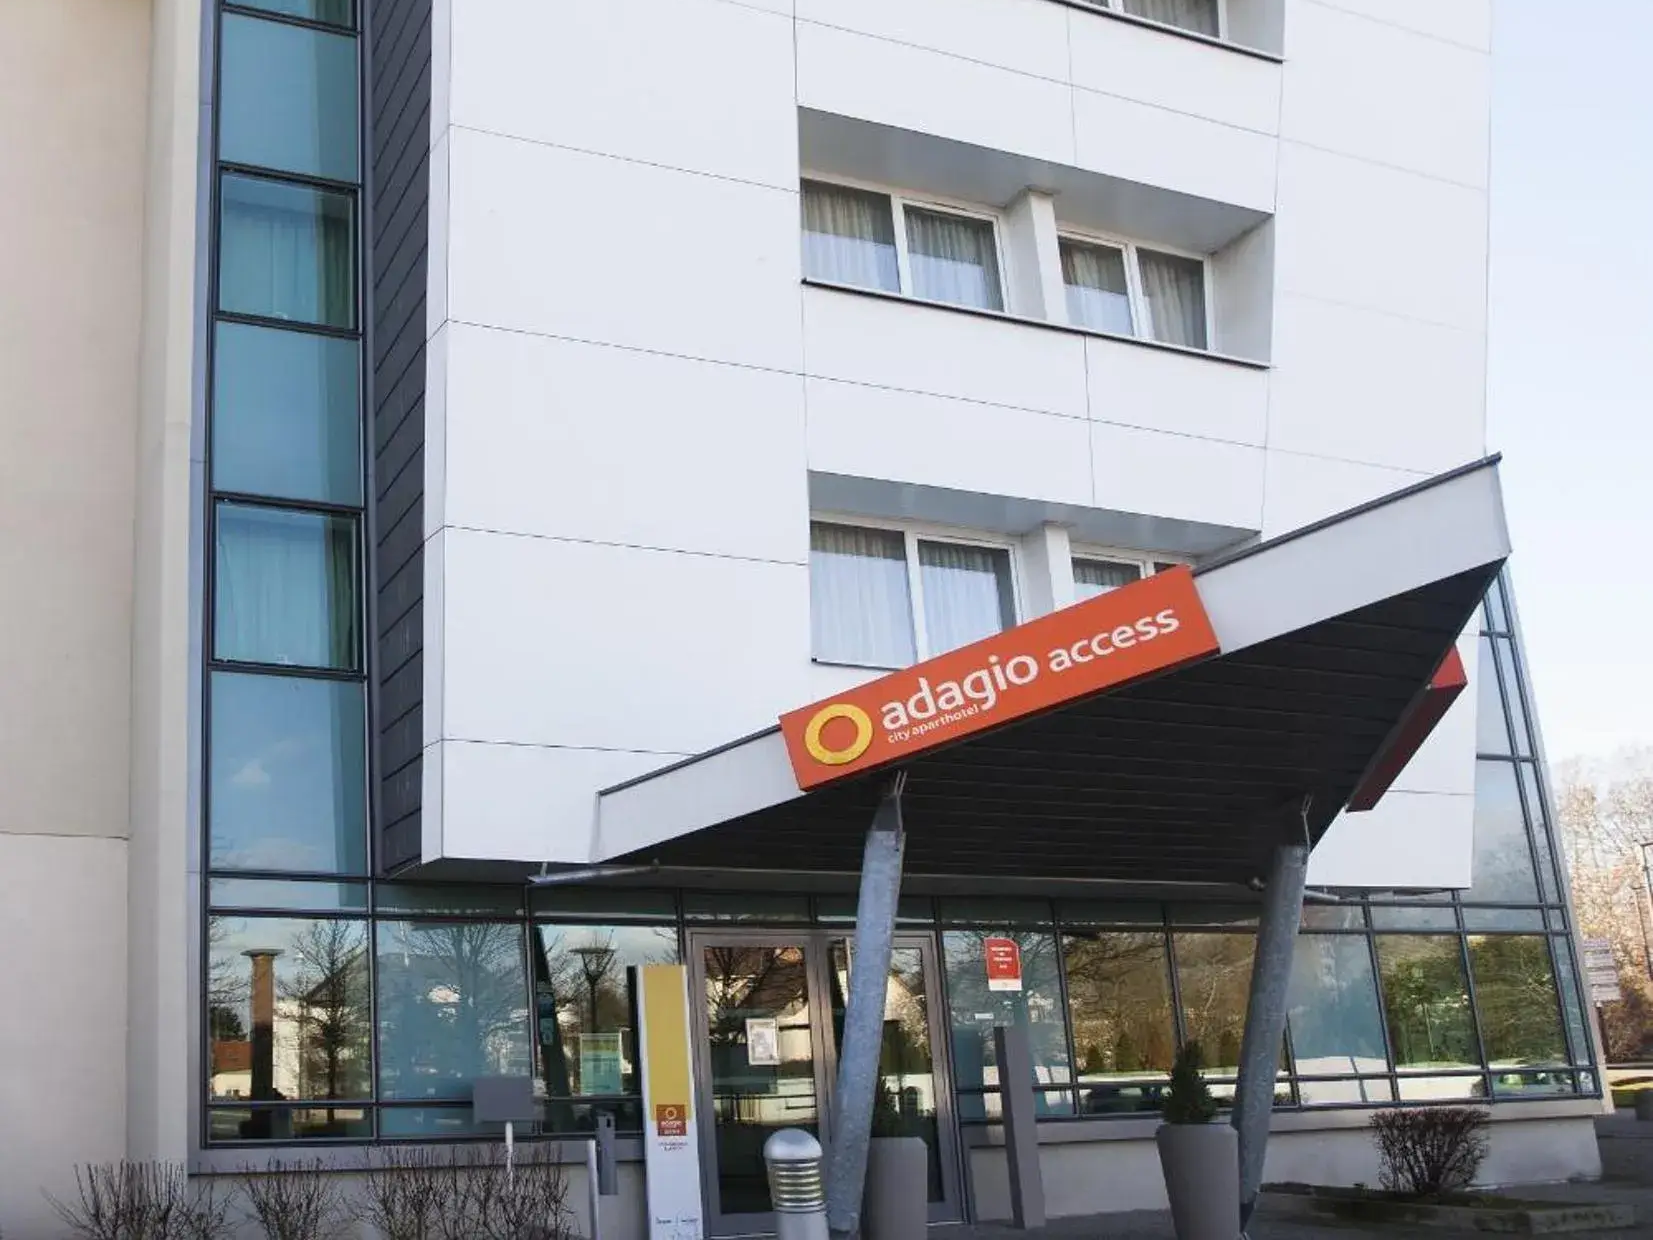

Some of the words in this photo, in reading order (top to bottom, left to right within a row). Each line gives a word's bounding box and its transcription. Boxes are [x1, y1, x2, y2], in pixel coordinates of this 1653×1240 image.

[880, 654, 1039, 732] adagio
[1049, 606, 1180, 674] access
[887, 726, 912, 745] city
[912, 703, 980, 737] aparthotel
